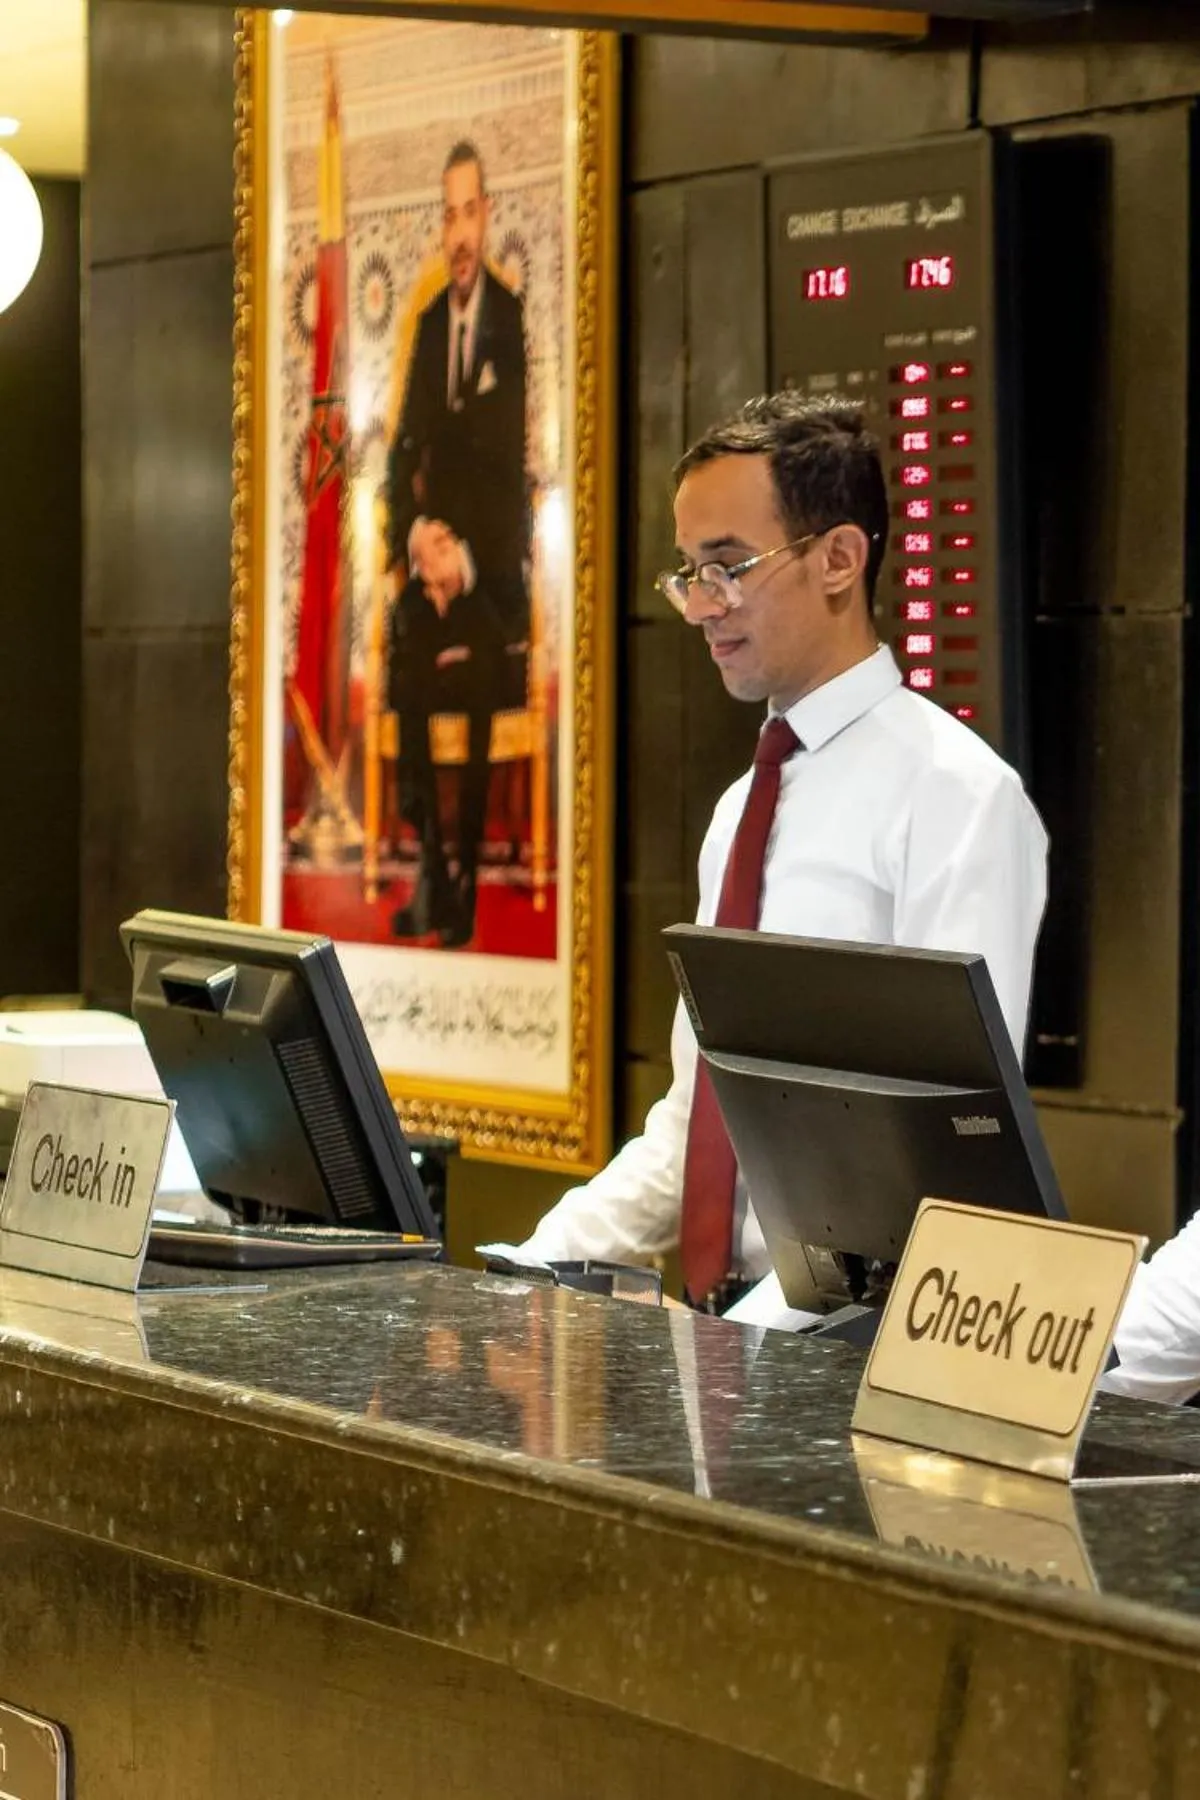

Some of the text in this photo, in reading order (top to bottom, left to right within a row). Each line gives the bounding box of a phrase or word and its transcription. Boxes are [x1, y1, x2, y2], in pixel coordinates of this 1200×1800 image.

[787, 201, 910, 240] CHANGE EXCHANGE
[31, 1133, 136, 1208] Check in
[906, 1266, 1095, 1374] Check out
